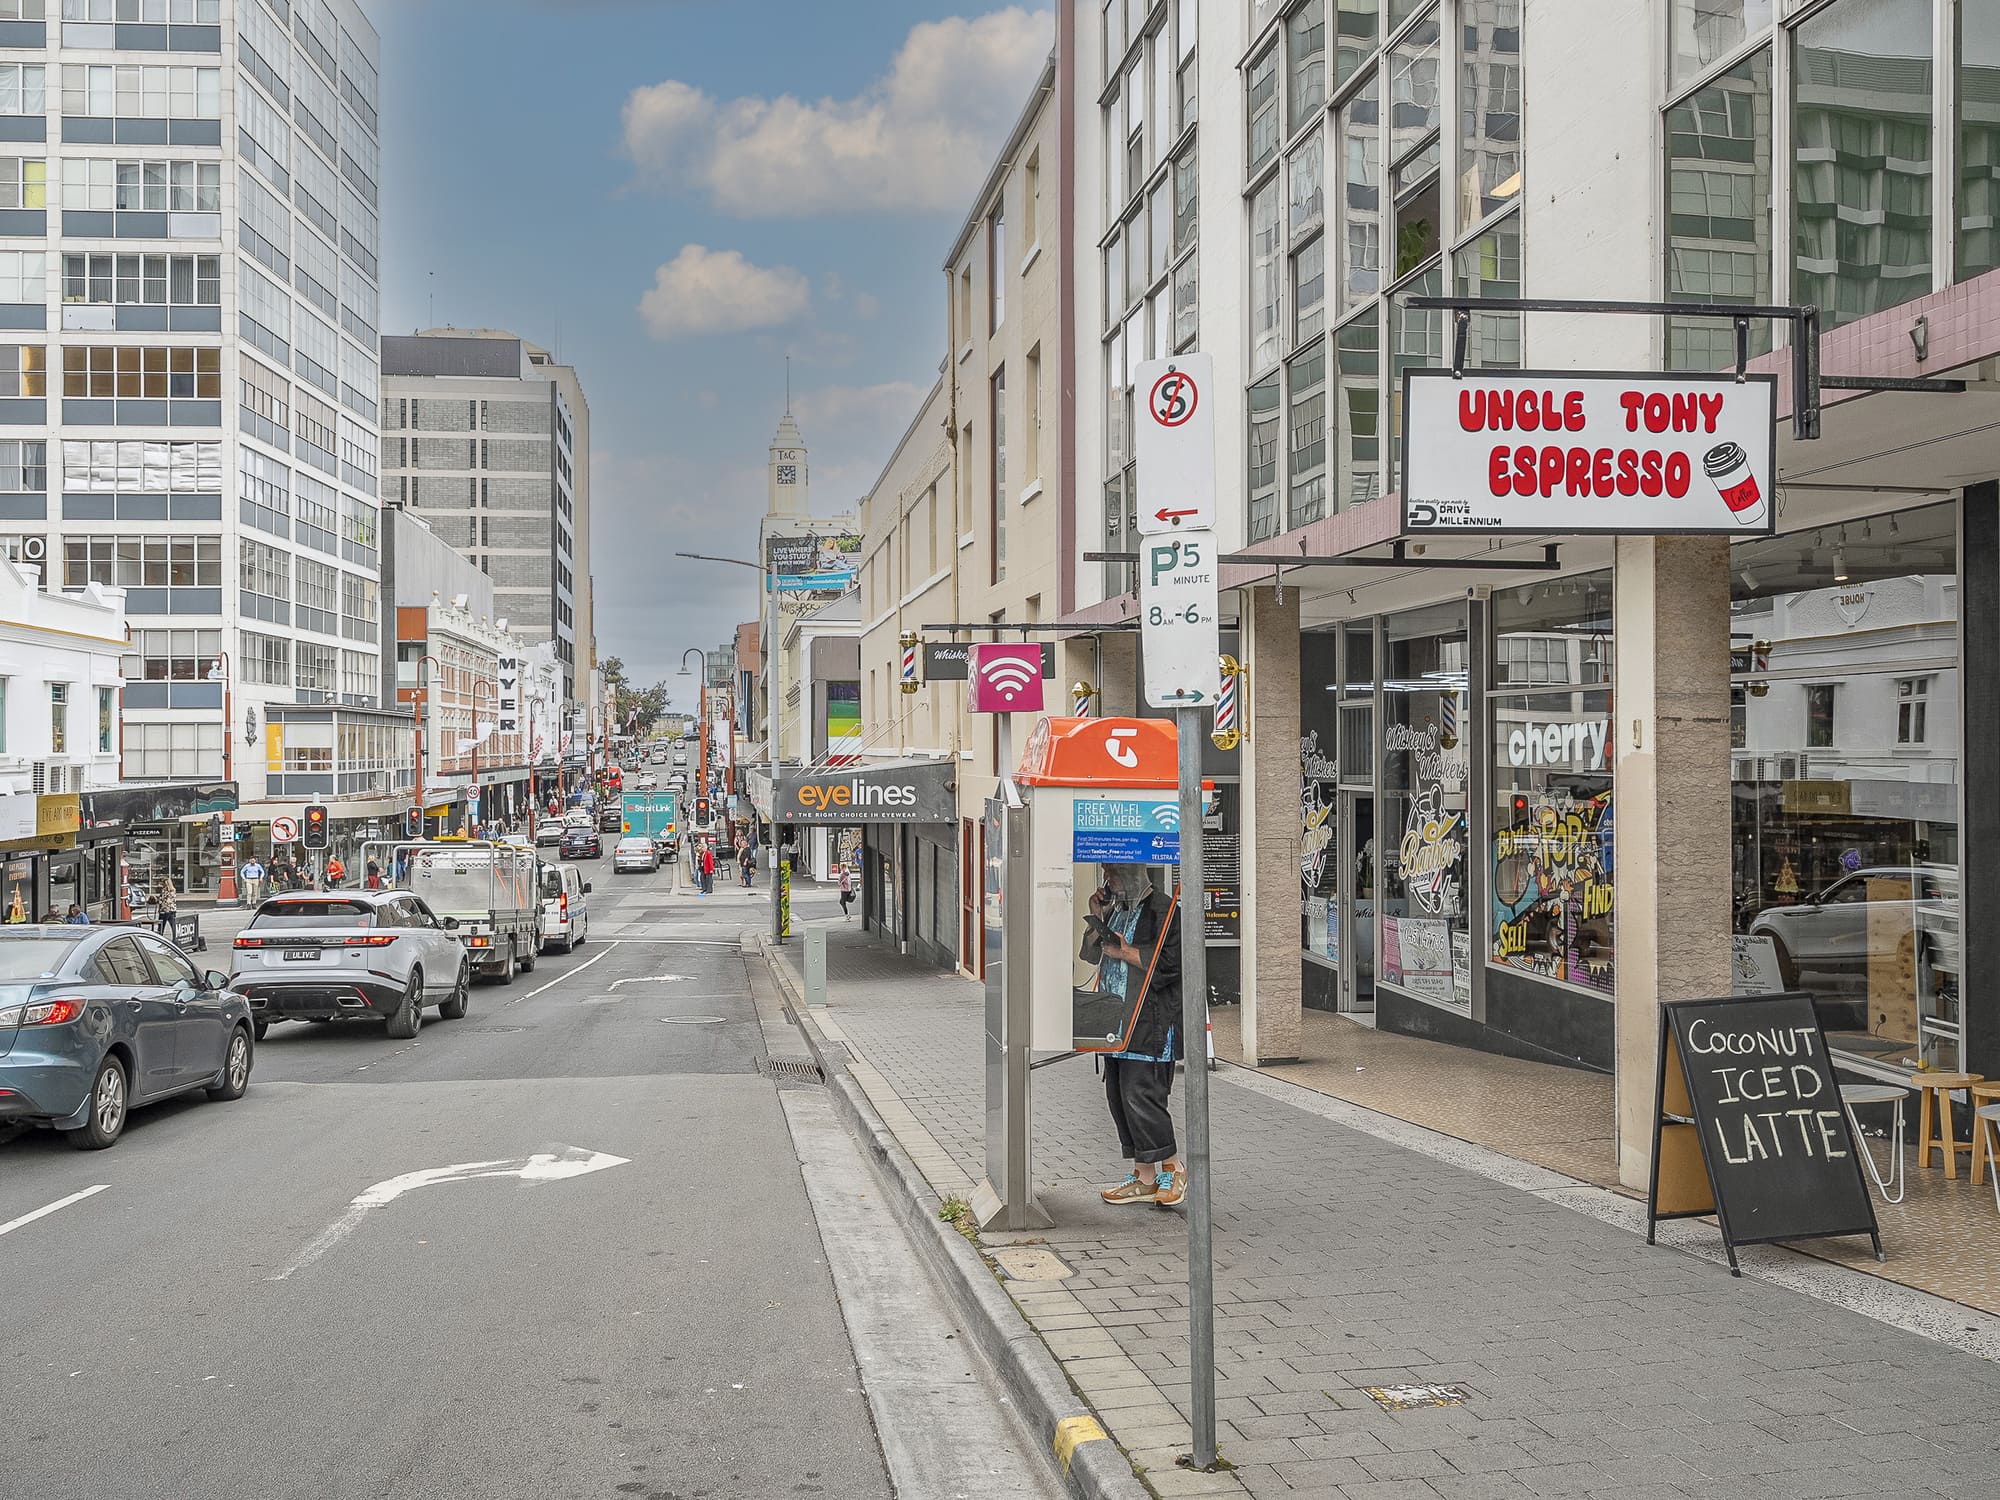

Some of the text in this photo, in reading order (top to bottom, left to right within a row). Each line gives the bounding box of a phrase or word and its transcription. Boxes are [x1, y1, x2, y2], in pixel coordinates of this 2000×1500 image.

[1459, 389, 1723, 433] UNCLE TONY
[1489, 445, 1691, 498] ESPRESSO
[1440, 505, 1470, 514] DRIVE
[1440, 517, 1501, 525] MILLENNIUM
[1152, 544, 1200, 586] P 5
[1173, 575, 1210, 585] MINUTE
[499, 658, 516, 731] MYER
[1420, 752, 1468, 780] Whiskers
[656, 804, 671, 812] Link
[798, 778, 917, 811] eyelines
[1077, 803, 1138, 815] FREE WI-FI
[1077, 815, 1142, 827] RIGHT HERE
[1399, 829, 1461, 881] Barber
[1583, 878, 1614, 920] FIND
[1498, 919, 1528, 958] SELL!
[1712, 1064, 1822, 1104] ICED
[1715, 1109, 1847, 1164] LATTE
